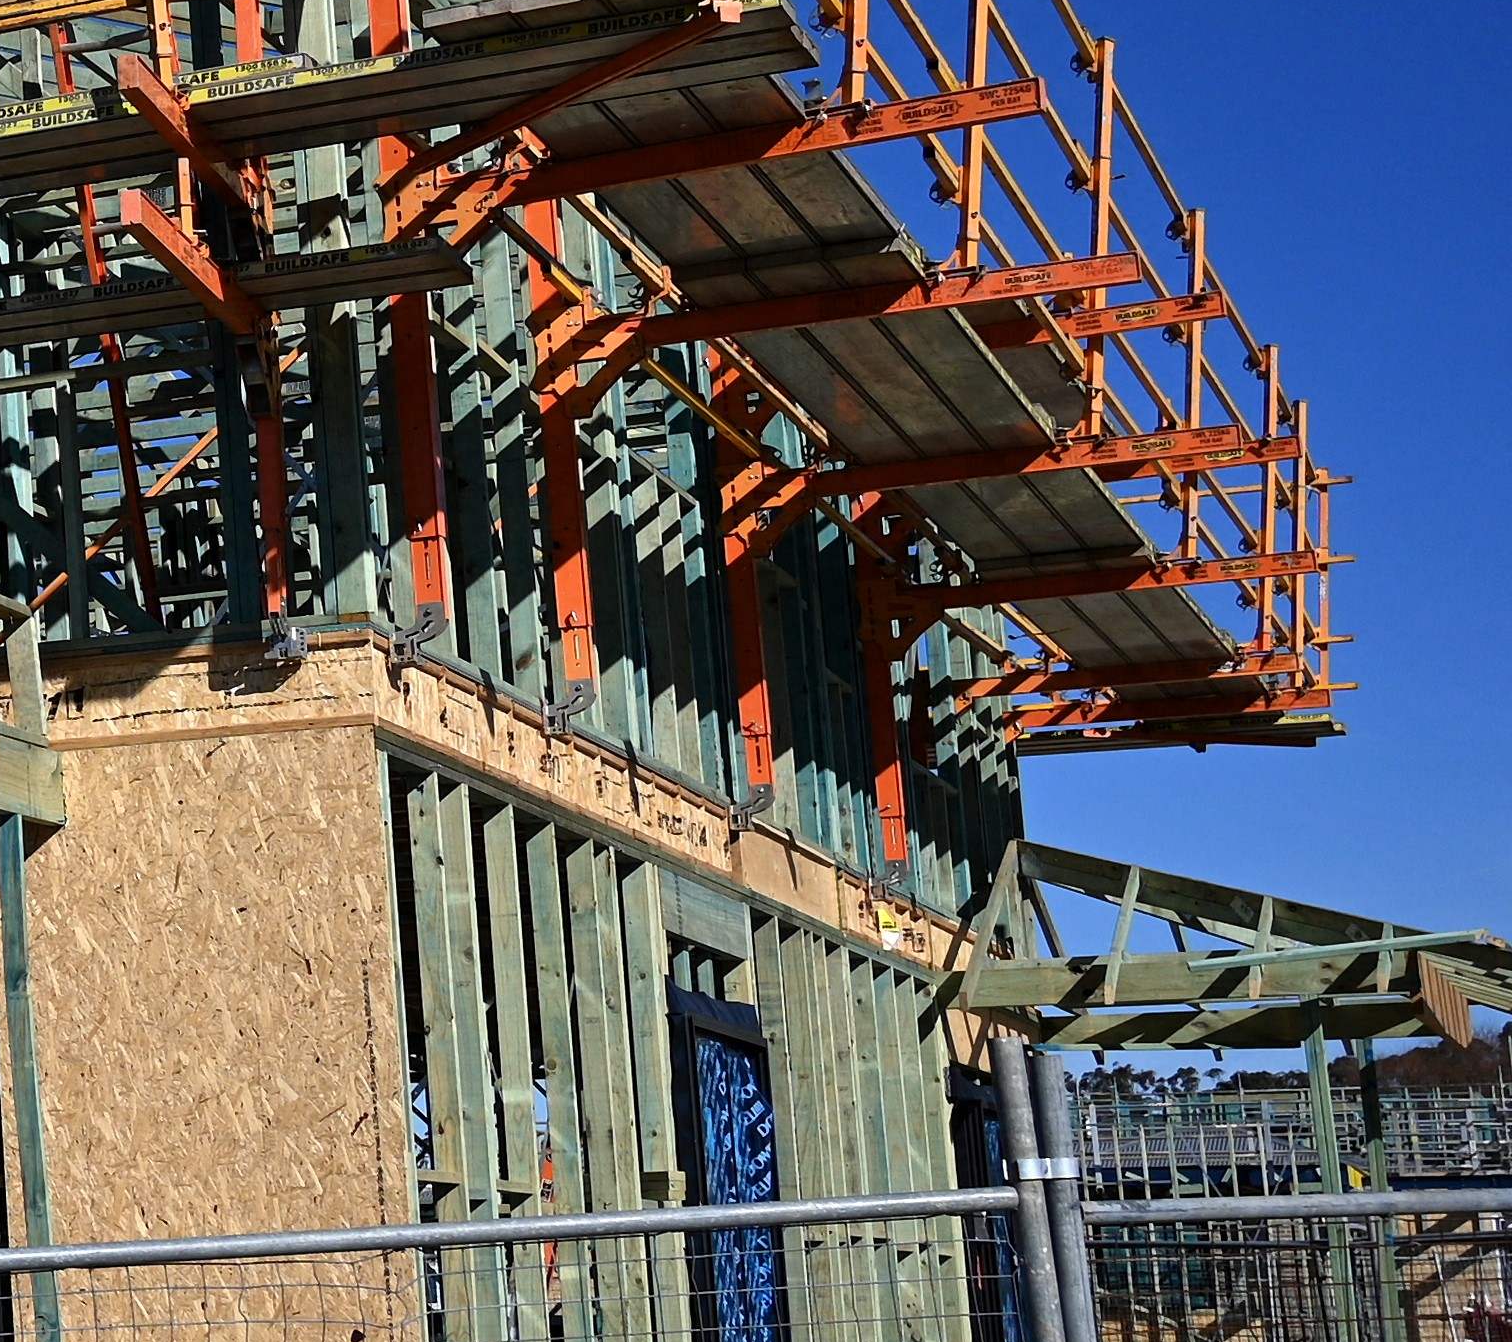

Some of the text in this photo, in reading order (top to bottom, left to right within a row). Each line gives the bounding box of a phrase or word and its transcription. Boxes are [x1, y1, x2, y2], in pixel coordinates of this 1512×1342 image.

[392, 41, 486, 68] BUILDSAFE
[587, 6, 686, 36] BUILDSAFE
[206, 74, 295, 99] BUILDSAFE
[31, 106, 115, 129] BUILDSAFE
[901, 103, 955, 121] BUILDSAFE
[264, 251, 350, 274] BUILDSAFE
[93, 276, 174, 299] BUILDSAFE
[1004, 271, 1052, 286] BUILDSAFE
[1114, 305, 1159, 322] BUILDSAFE
